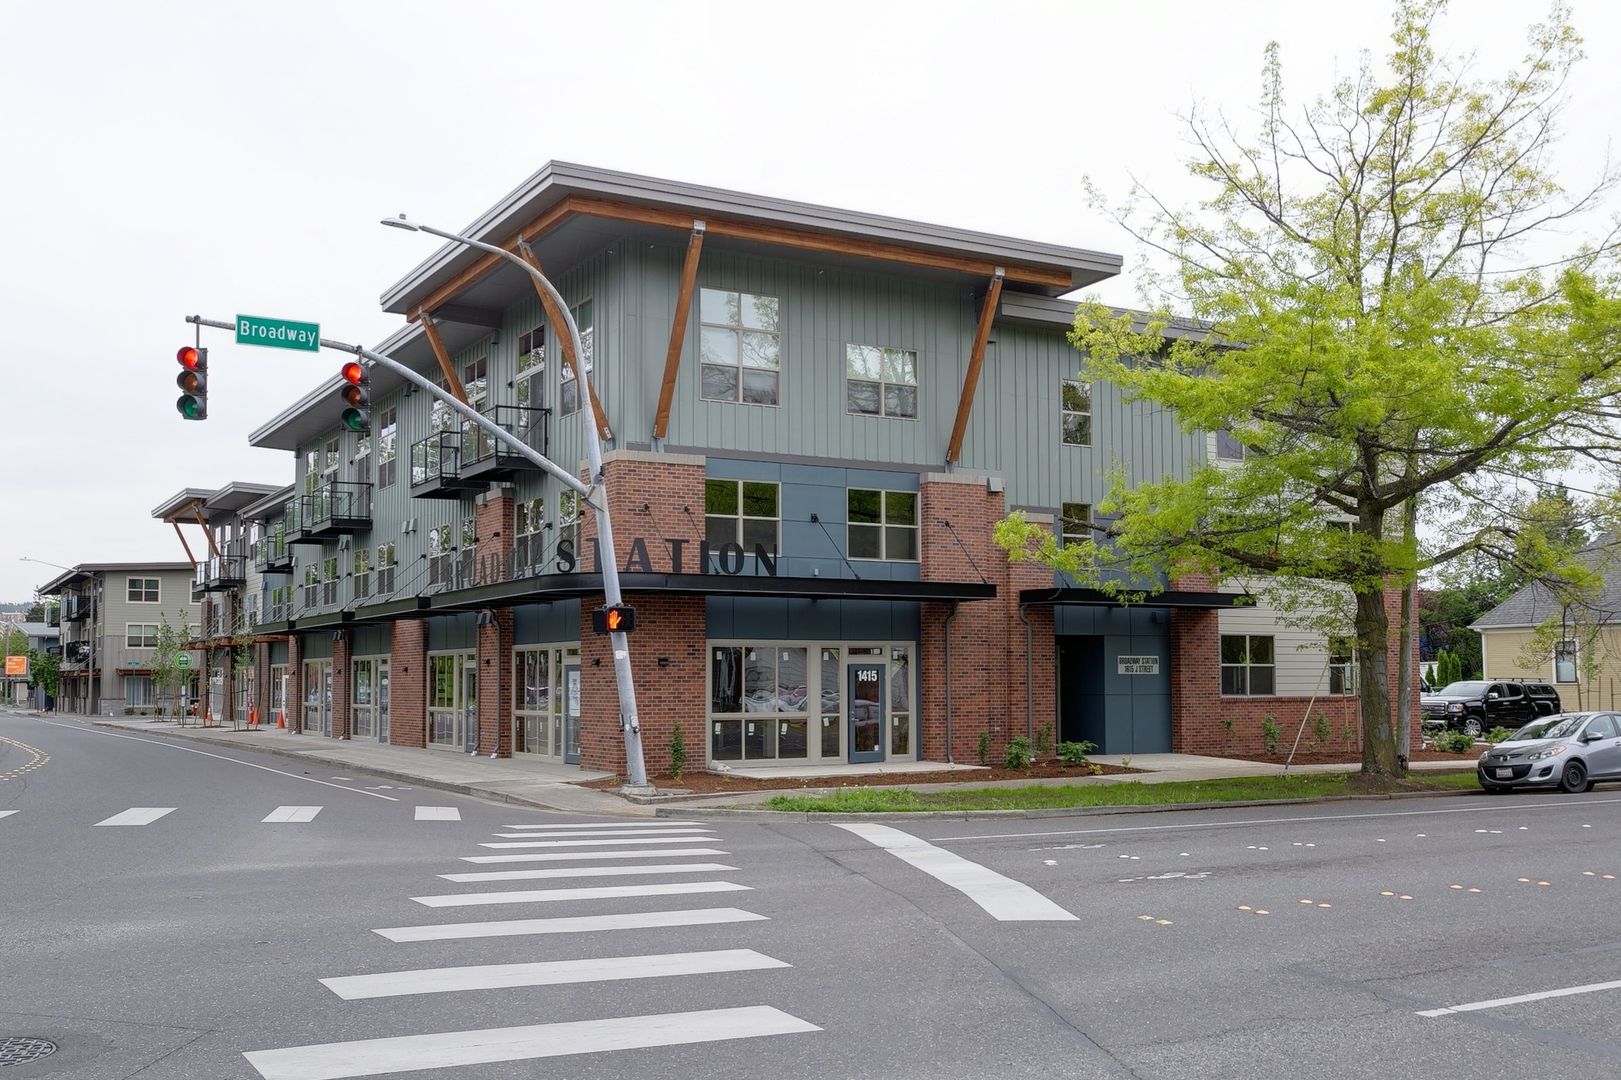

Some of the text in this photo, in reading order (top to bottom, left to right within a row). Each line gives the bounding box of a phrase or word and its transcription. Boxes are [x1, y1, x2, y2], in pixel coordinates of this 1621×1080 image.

[240, 320, 316, 347] Broadway
[556, 537, 778, 576] STATION
[857, 670, 877, 681] 1415
